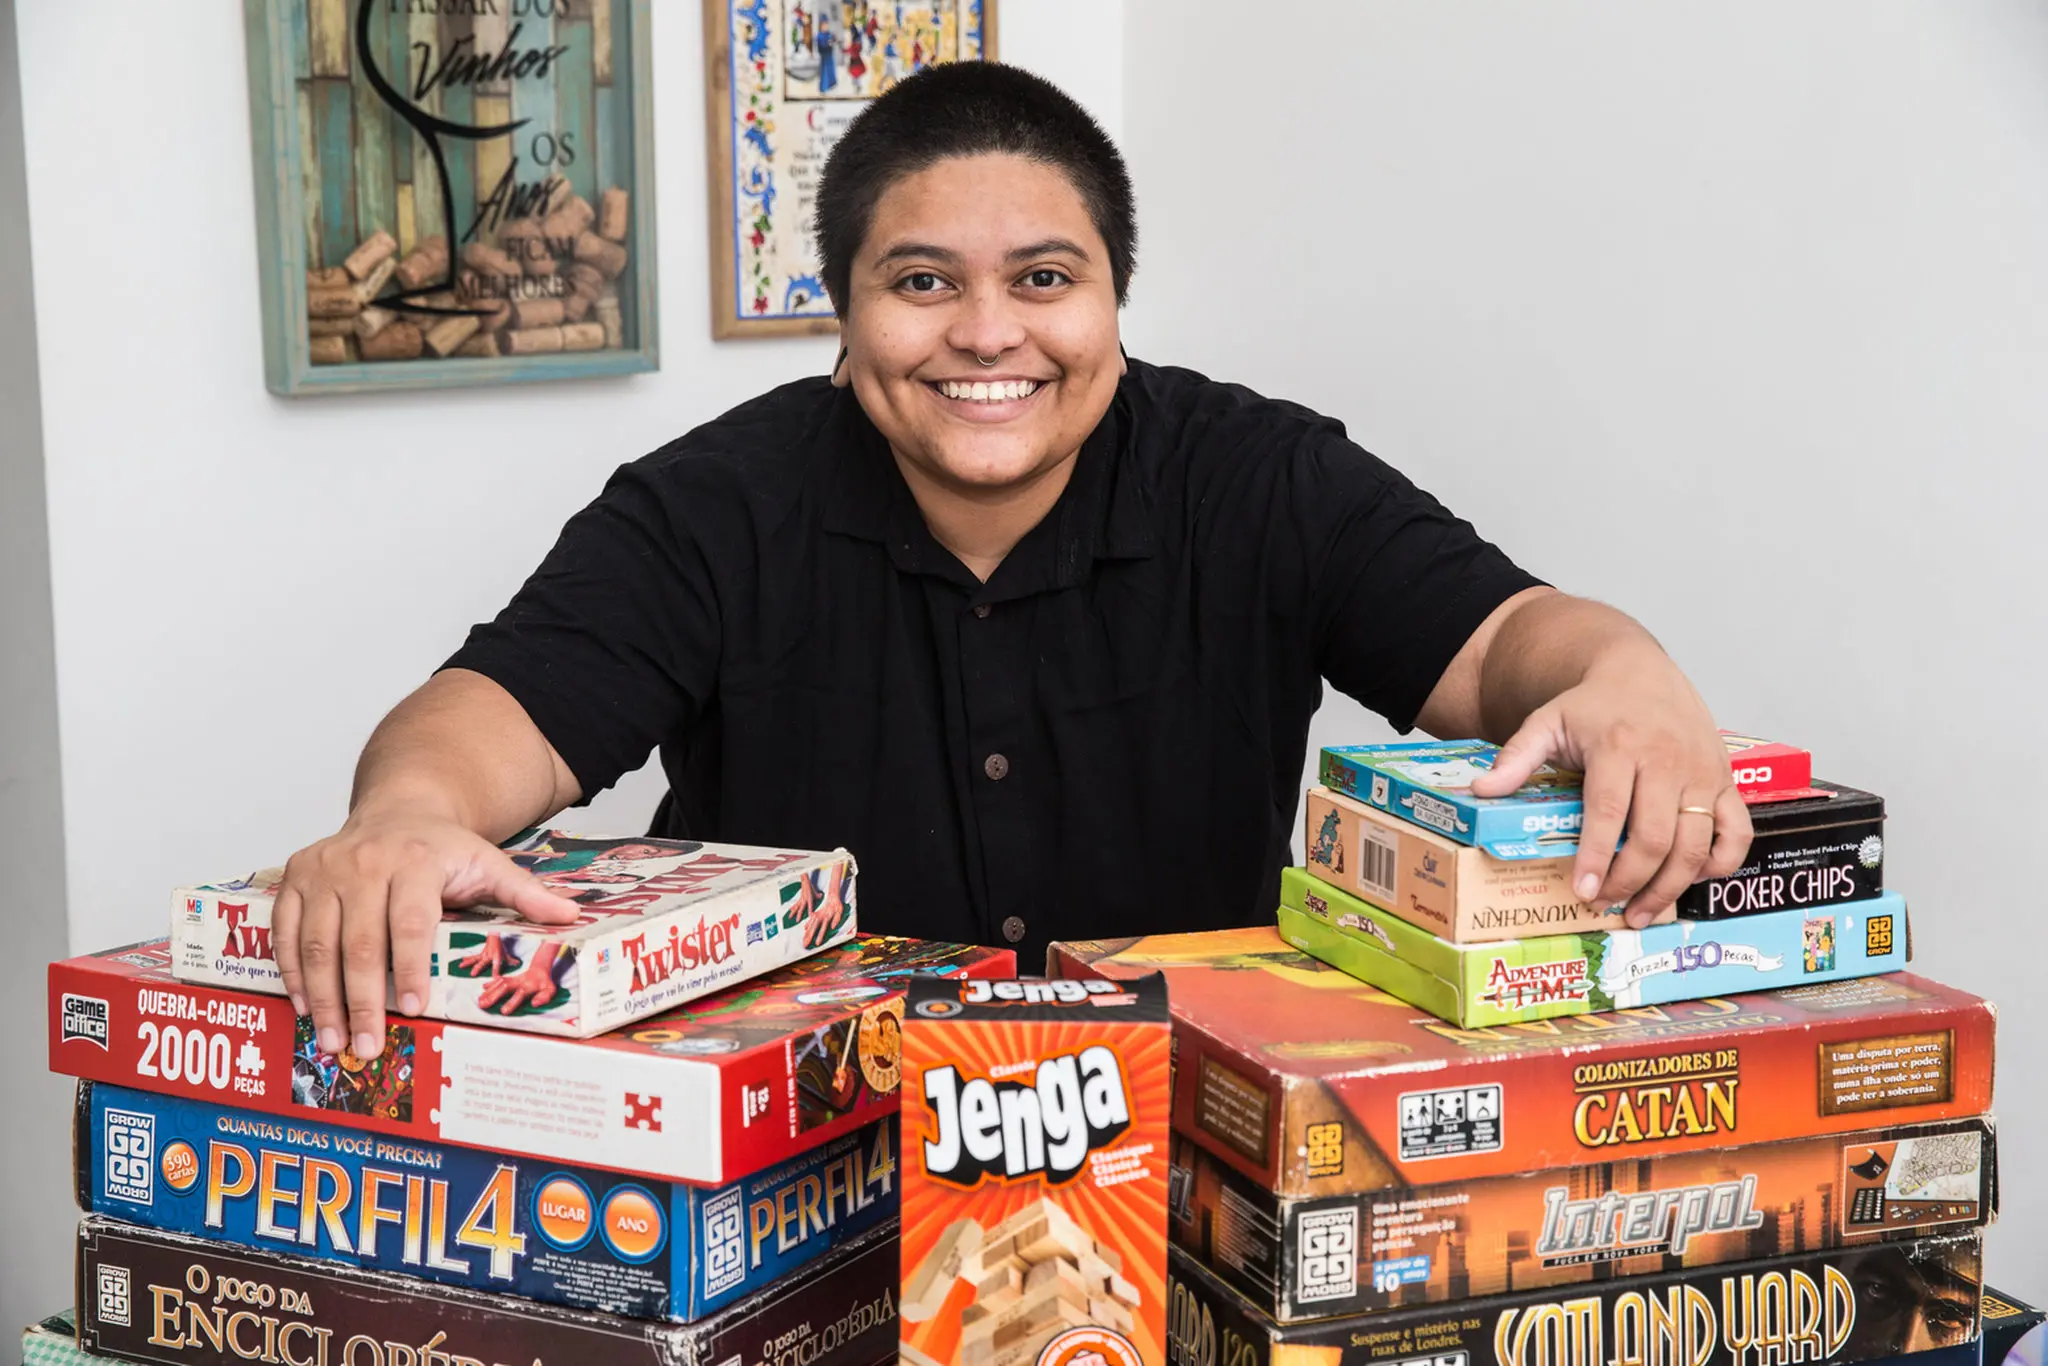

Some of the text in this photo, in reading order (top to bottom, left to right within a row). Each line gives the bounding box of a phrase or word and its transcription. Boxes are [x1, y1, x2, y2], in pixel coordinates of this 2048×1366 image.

[413, 23, 569, 100] Vinhos
[532, 132, 576, 166] OS
[507, 237, 575, 262] FICAM
[457, 275, 577, 300] MELHORES
[1708, 864, 1856, 915] POKER CHIPS
[187, 899, 203, 914] MB
[1472, 904, 1580, 931] MUNCHKIN
[622, 913, 740, 995] Twister
[1631, 957, 1669, 978] Puzzle
[1672, 940, 1722, 973] 150
[215, 959, 223, 971] O
[223, 960, 246, 976] jogo
[248, 966, 265, 979] que
[1489, 959, 1586, 986] ADVENTURE
[965, 980, 1118, 1004] Jenga
[1506, 977, 1586, 1009] TIME
[137, 988, 267, 1037] QUEBRA-CABEÇA
[137, 1021, 231, 1090] 2000
[1832, 1043, 1941, 1062] Uma disputa por terra,
[989, 1060, 1037, 1079] Classic
[1574, 1049, 1738, 1084] COLONIZADORES DE
[1832, 1060, 1899, 1076] matéria-prima
[1910, 1056, 1941, 1069] poder,
[234, 1077, 265, 1098] PEÇAS
[1833, 1070, 1939, 1090] numa ilha onde só um
[1836, 1083, 1937, 1105] pode ter a soberania.
[109, 1114, 151, 1129] GROW
[924, 1045, 1130, 1176] Jenga
[1574, 1079, 1739, 1147] CATAN
[217, 1116, 443, 1169] QUANTAS DICAS VOCÊ PRECISA?
[166, 1151, 191, 1172] 390
[168, 1166, 195, 1182] cartas
[109, 1183, 149, 1200] GROW
[1399, 1193, 1470, 1211] emocionante
[542, 1200, 586, 1222] LUGAR
[707, 1192, 739, 1217] GROW
[617, 1215, 648, 1234] ANO
[1304, 1213, 1353, 1229] GROW
[1372, 1211, 1423, 1227] aventura
[1372, 1218, 1456, 1240] de perseguição
[1372, 1237, 1416, 1253] policial.
[1583, 1253, 1598, 1262] EM
[1603, 1249, 1629, 1260] NOVA
[1634, 1245, 1660, 1255] YORK
[100, 1267, 128, 1279] GROW
[1375, 1258, 1426, 1273] a partir de
[186, 1264, 315, 1315] O JOGO DA
[1375, 1269, 1427, 1294] 10 anos
[1721, 1263, 1857, 1366] YARD
[1351, 1318, 1481, 1347] Suspense e mistério nas
[763, 1340, 774, 1358] O
[1371, 1334, 1463, 1357] ruas de Londres.
